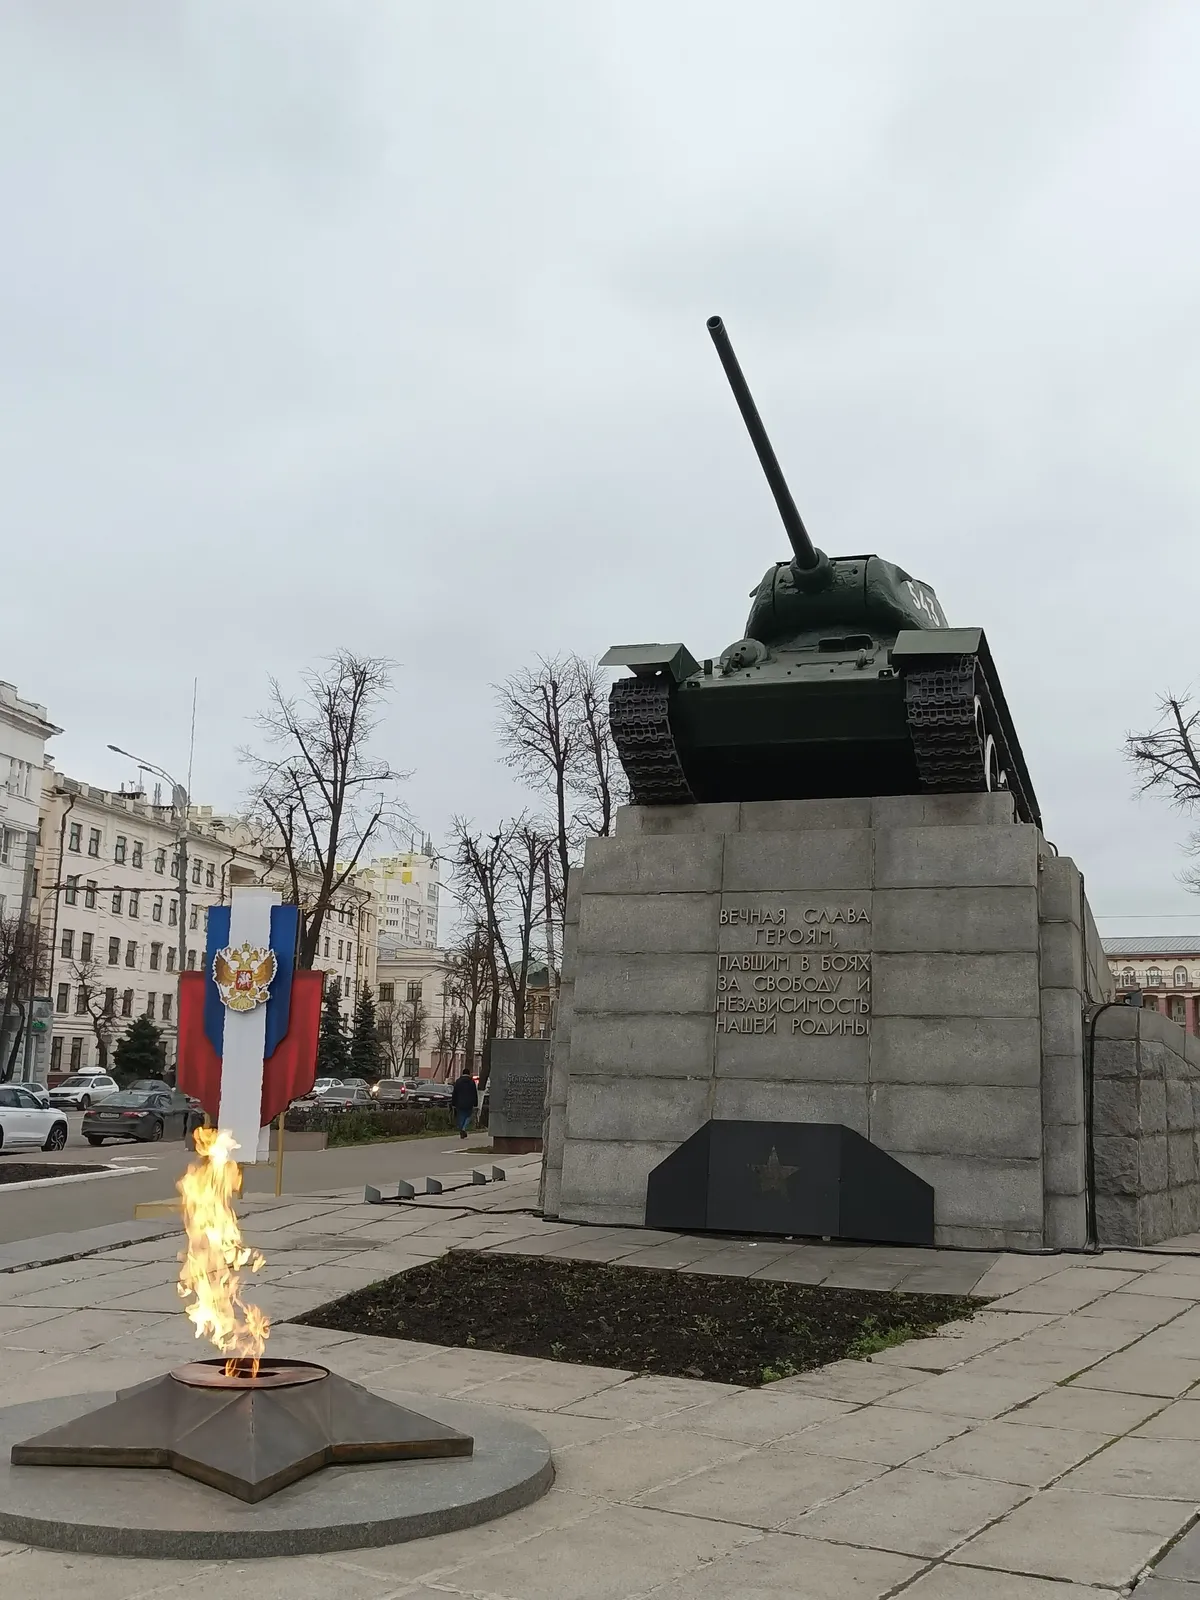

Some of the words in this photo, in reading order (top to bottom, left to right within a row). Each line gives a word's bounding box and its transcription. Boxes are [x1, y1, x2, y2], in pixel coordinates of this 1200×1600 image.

[719, 908, 787, 925] ВЕЧНАЯ
[803, 908, 871, 924] СЛАВА
[755, 929, 839, 948] ГЕРОЯМ,
[718, 954, 790, 971] ПАВШИМ
[801, 955, 810, 971] В
[821, 954, 871, 971] БОЯХ
[717, 976, 741, 991] ЗА
[752, 975, 842, 992] СВОБОДУ
[857, 976, 870, 992] И
[716, 996, 870, 1014] НЕЗАВИСИМОСТЬ
[715, 1014, 777, 1034] НАШЕЙ
[792, 1018, 870, 1035] РОДИНЫ
